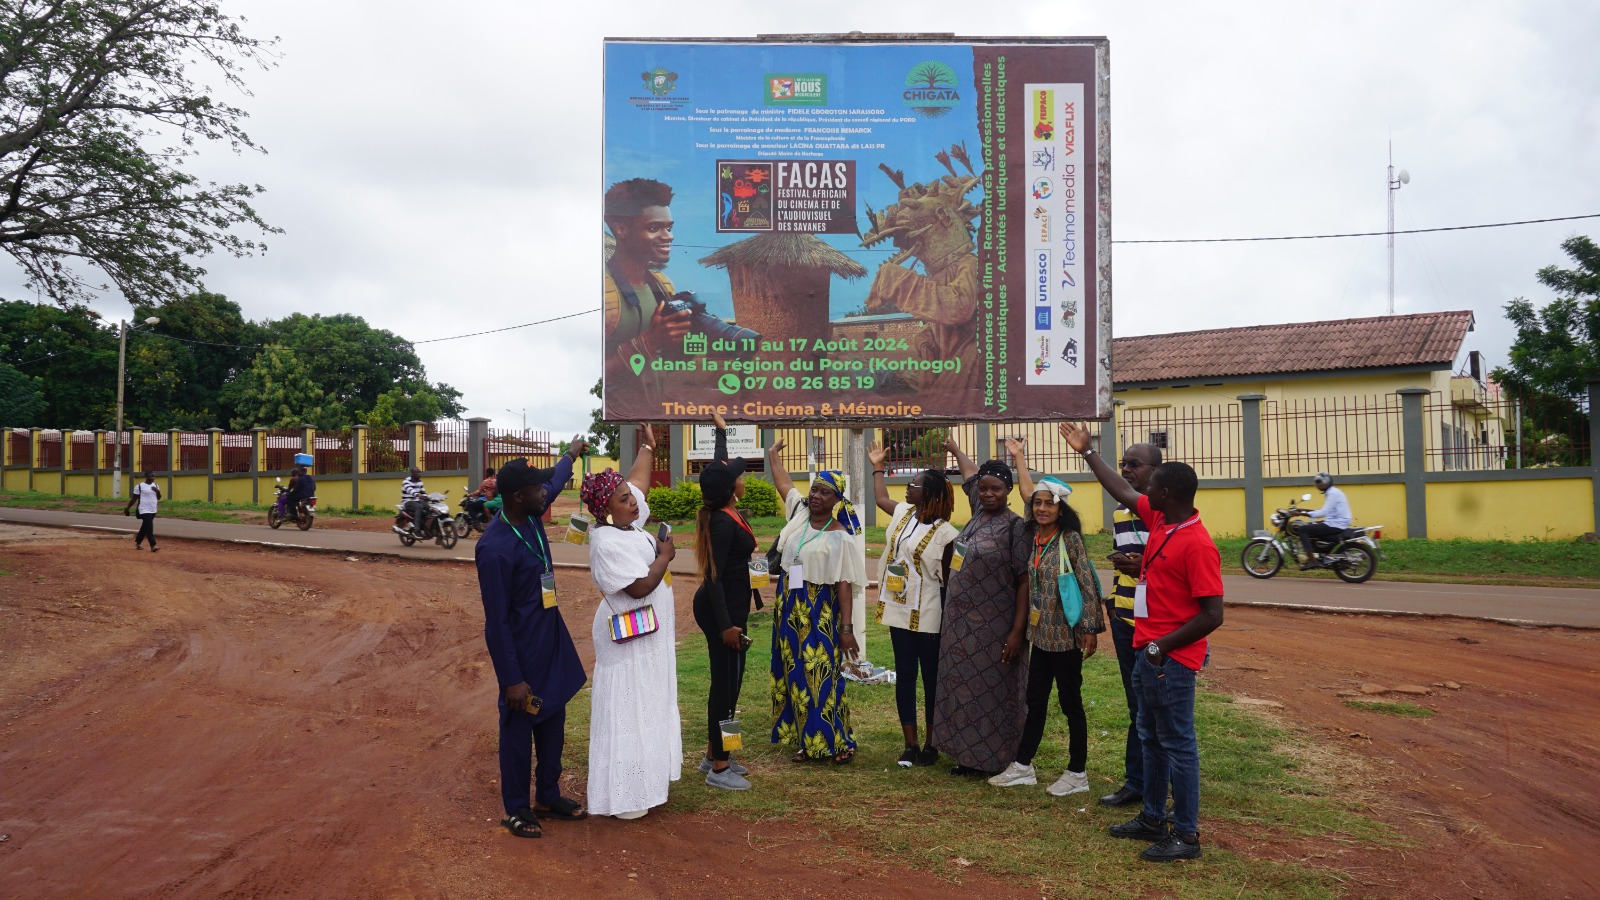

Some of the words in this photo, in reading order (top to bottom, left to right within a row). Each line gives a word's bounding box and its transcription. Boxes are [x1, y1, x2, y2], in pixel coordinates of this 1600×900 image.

[794, 82, 821, 92] NOUS
[902, 90, 960, 100] CHIGATA
[995, 56, 1007, 134] didactiques
[982, 63, 994, 170] professionnelles
[1065, 102, 1075, 156] VICAFLIX
[997, 137, 1006, 150] et
[778, 162, 847, 189] FACAS
[997, 154, 1008, 210] ludiques
[778, 189, 810, 199] FESTIVAL
[812, 189, 847, 199] AFRICAIN
[778, 200, 788, 209] DU
[790, 200, 819, 209] CINEMA
[821, 200, 830, 209] ET
[831, 200, 840, 209] DE
[983, 174, 993, 250] Rencontres
[1063, 164, 1075, 268] Technomedia
[778, 222, 792, 231] DES
[794, 222, 827, 231] SAVANES
[996, 214, 1006, 272] Activités
[983, 262, 993, 289] film
[984, 292, 993, 309] de
[997, 284, 1008, 365] touristiques
[712, 338, 736, 351] du
[741, 339, 755, 351] 11
[761, 341, 784, 351] au
[789, 338, 807, 351] 17
[813, 338, 858, 351] Août
[863, 338, 909, 351] 2024
[651, 358, 697, 371] dans
[702, 358, 718, 371] la
[723, 357, 784, 374] région
[790, 358, 814, 371] du
[820, 358, 863, 371] Poro
[869, 357, 961, 374] (Korhogo)
[984, 312, 995, 406] Récompenses
[744, 376, 767, 390] 07
[773, 376, 796, 390] 08
[801, 376, 824, 390] 26
[828, 376, 850, 390] 85
[856, 376, 874, 390] 19
[997, 366, 1007, 412] Visites
[662, 401, 728, 415] Thème
[733, 404, 737, 414] :
[744, 402, 814, 416] Cinéma
[820, 402, 833, 415] &
[839, 401, 922, 415] Mémoire
